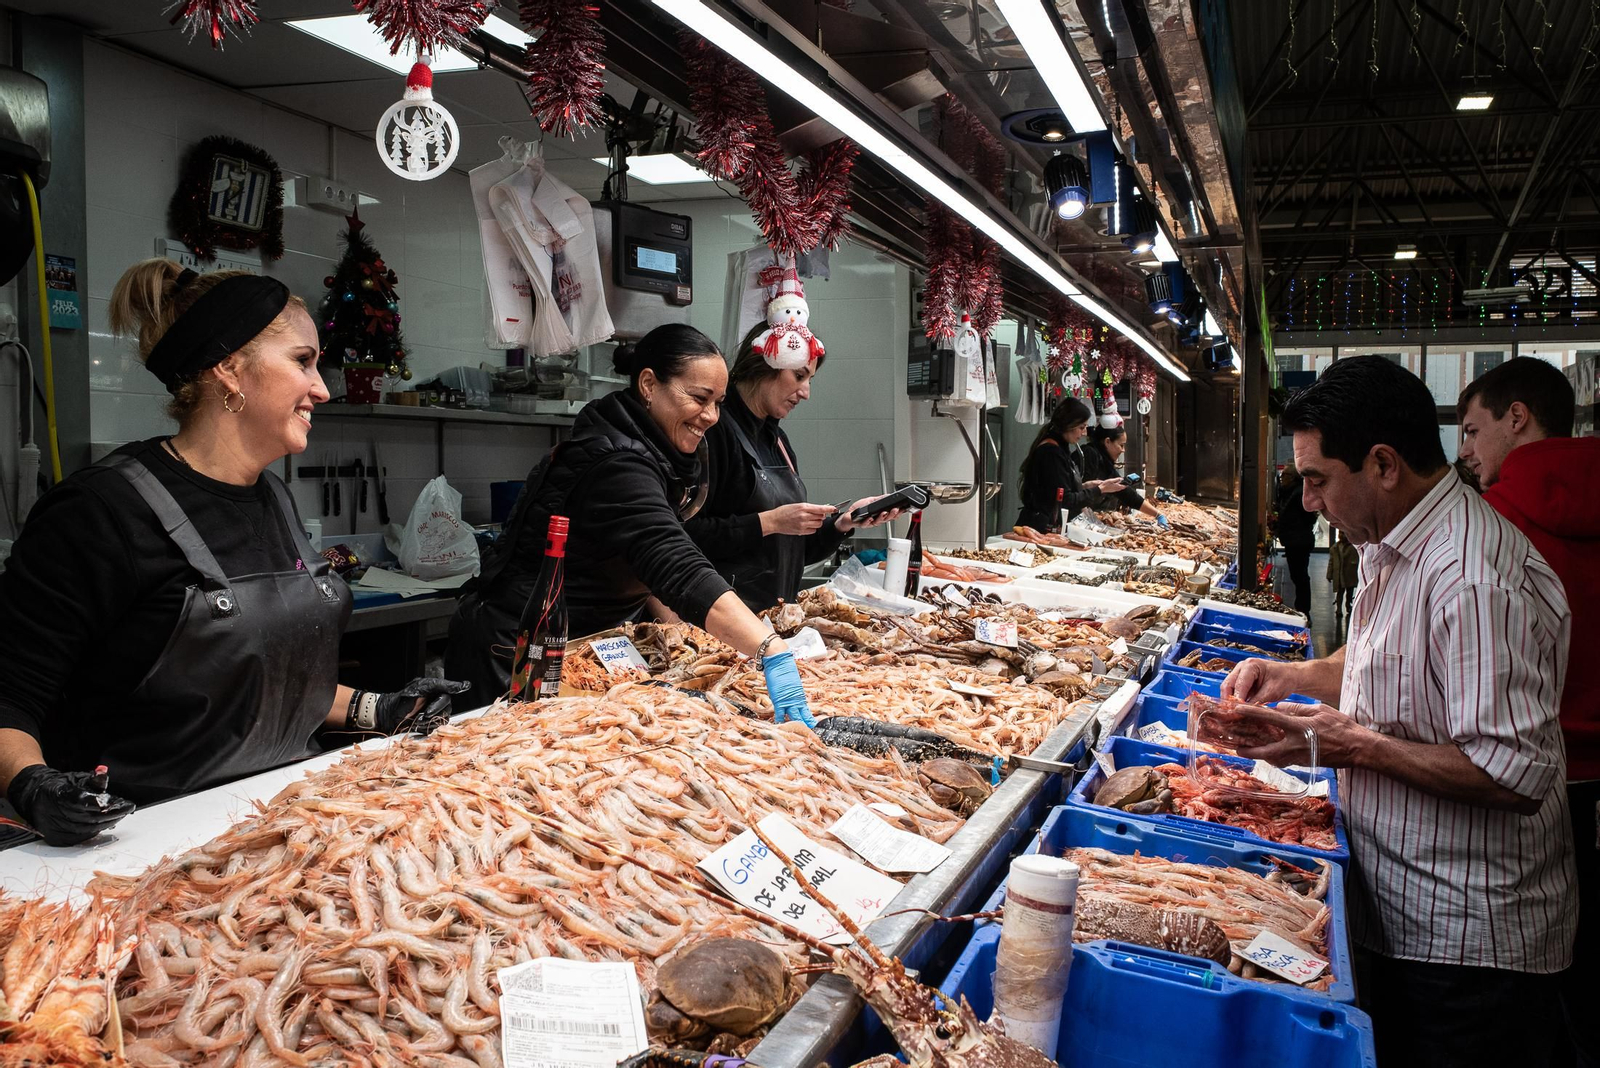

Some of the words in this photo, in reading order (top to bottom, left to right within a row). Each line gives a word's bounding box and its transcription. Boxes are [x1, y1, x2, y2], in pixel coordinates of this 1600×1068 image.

[52, 304, 79, 316] 2023
[54, 300, 74, 308] FELIZ
[431, 511, 459, 529] MARISCOS
[595, 639, 632, 652] MARISCADA
[754, 888, 776, 909] DE
[771, 875, 789, 892] LA
[781, 848, 816, 881] PNTA
[782, 902, 806, 920] DEL
